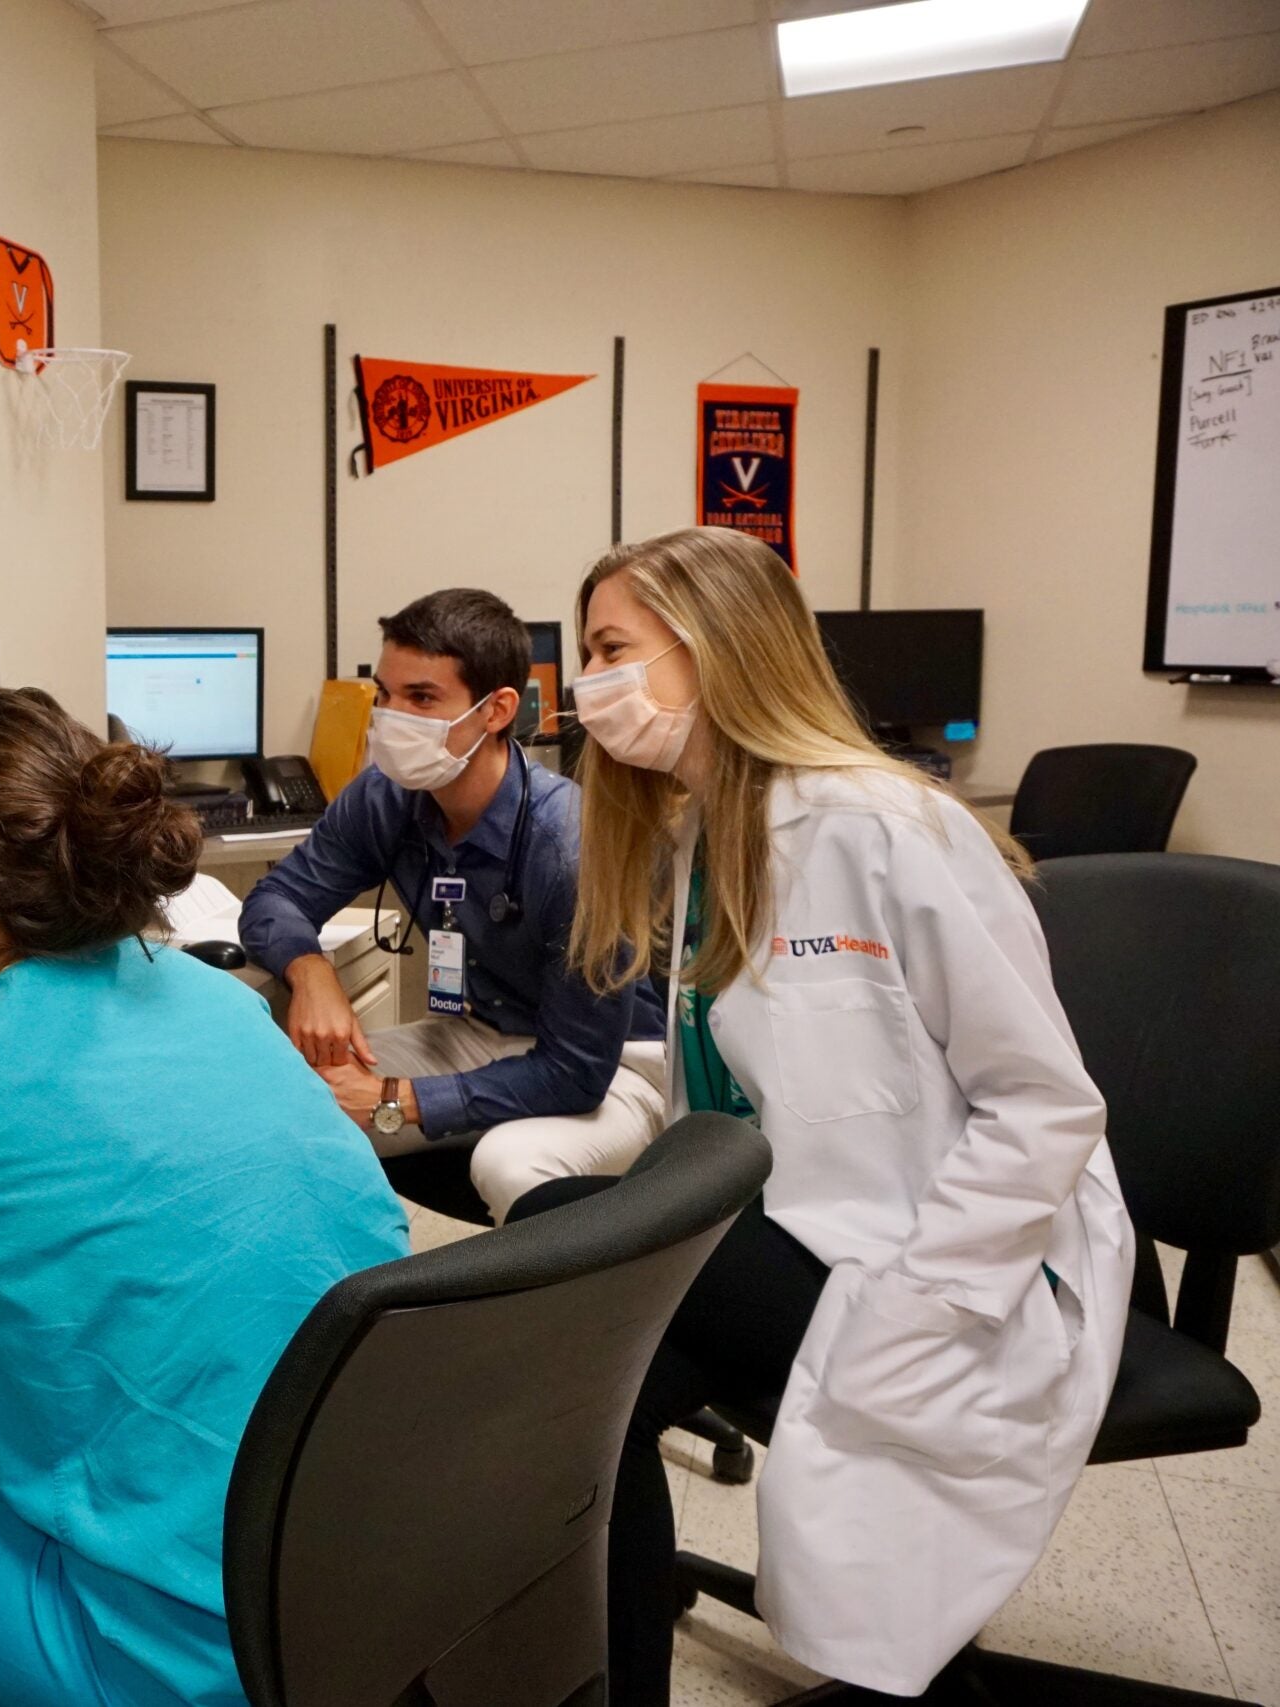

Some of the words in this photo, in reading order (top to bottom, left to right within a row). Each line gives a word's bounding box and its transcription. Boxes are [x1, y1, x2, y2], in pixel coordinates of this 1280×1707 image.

[12, 281, 28, 316] V
[433, 378, 513, 400] UNIVERSITY
[516, 378, 534, 389] OF
[435, 388, 538, 431] VIRGINIA
[715, 408, 781, 430] VIRGINIA
[730, 456, 761, 492] V
[430, 996, 462, 1012] Doctor
